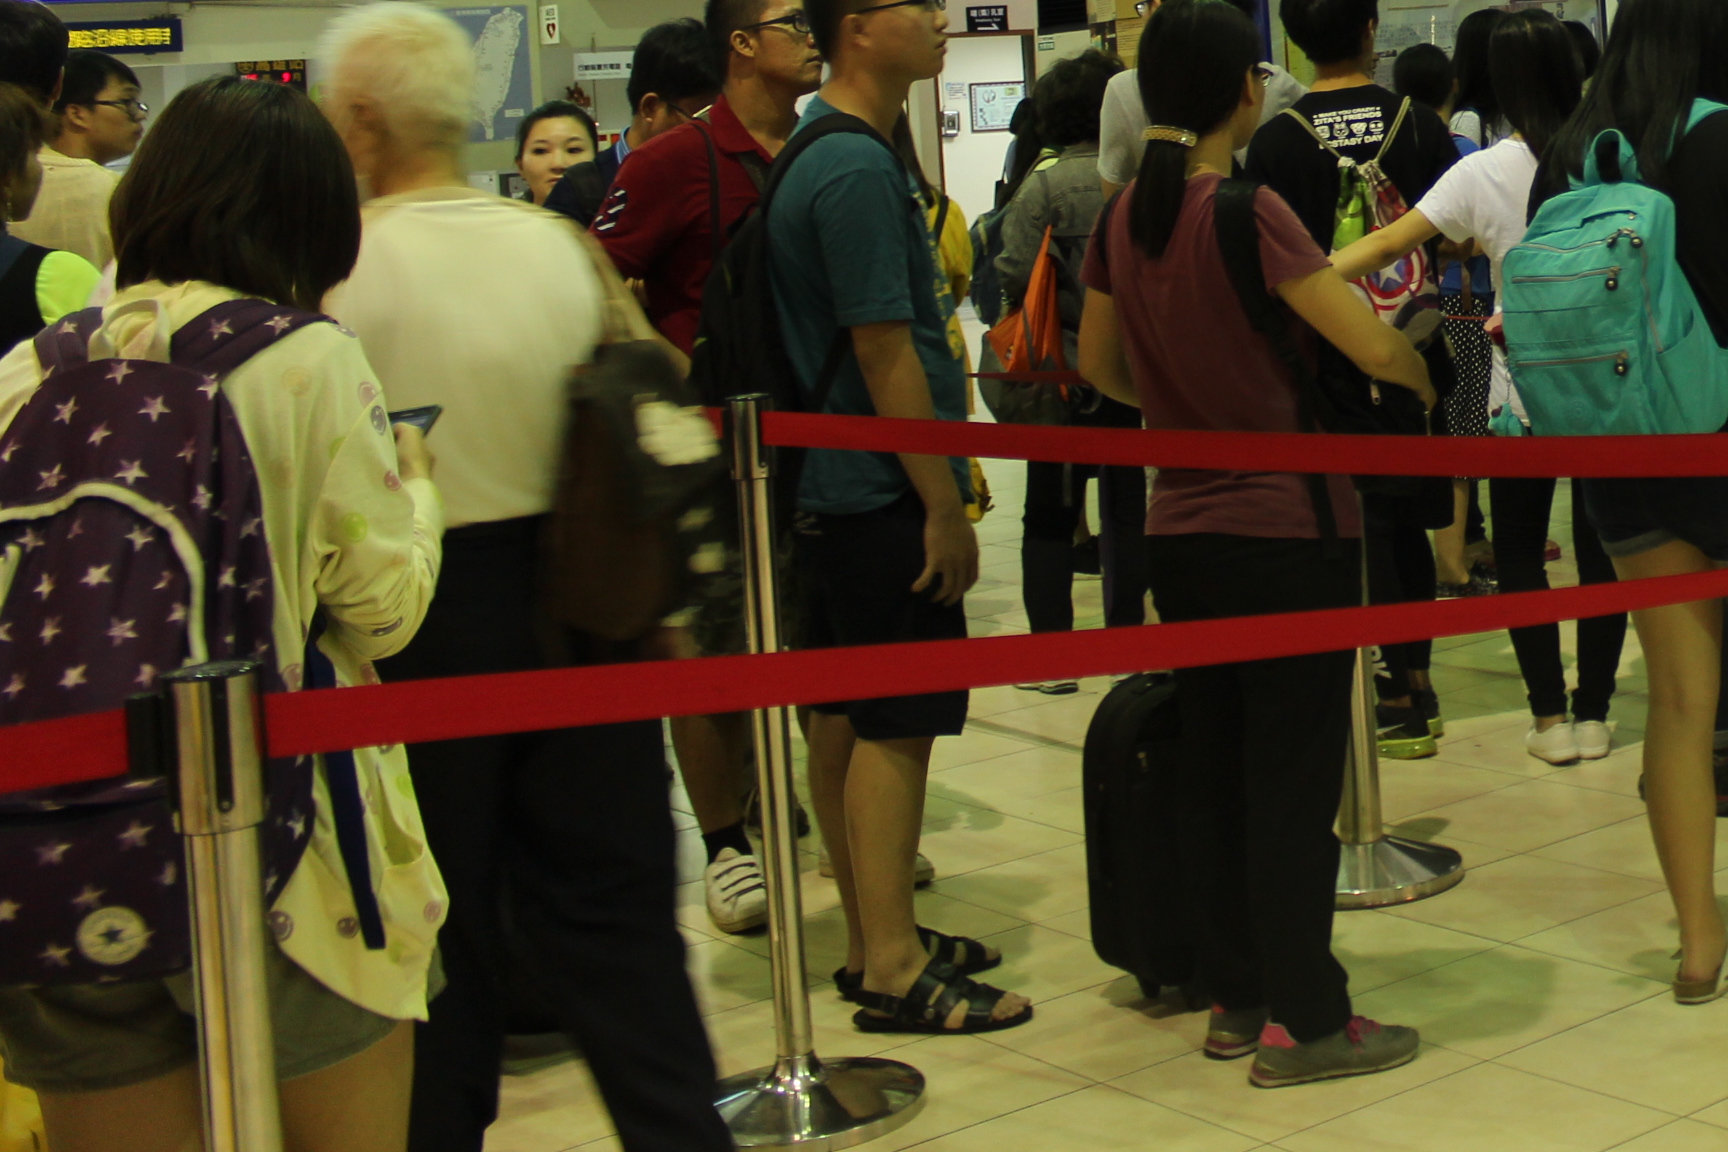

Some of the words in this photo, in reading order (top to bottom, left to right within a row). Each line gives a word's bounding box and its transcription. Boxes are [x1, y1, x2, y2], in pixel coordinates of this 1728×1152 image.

[1313, 115, 1342, 126] ZITA'S
[1342, 111, 1382, 121] FRIENDS
[1364, 133, 1384, 144] DAY
